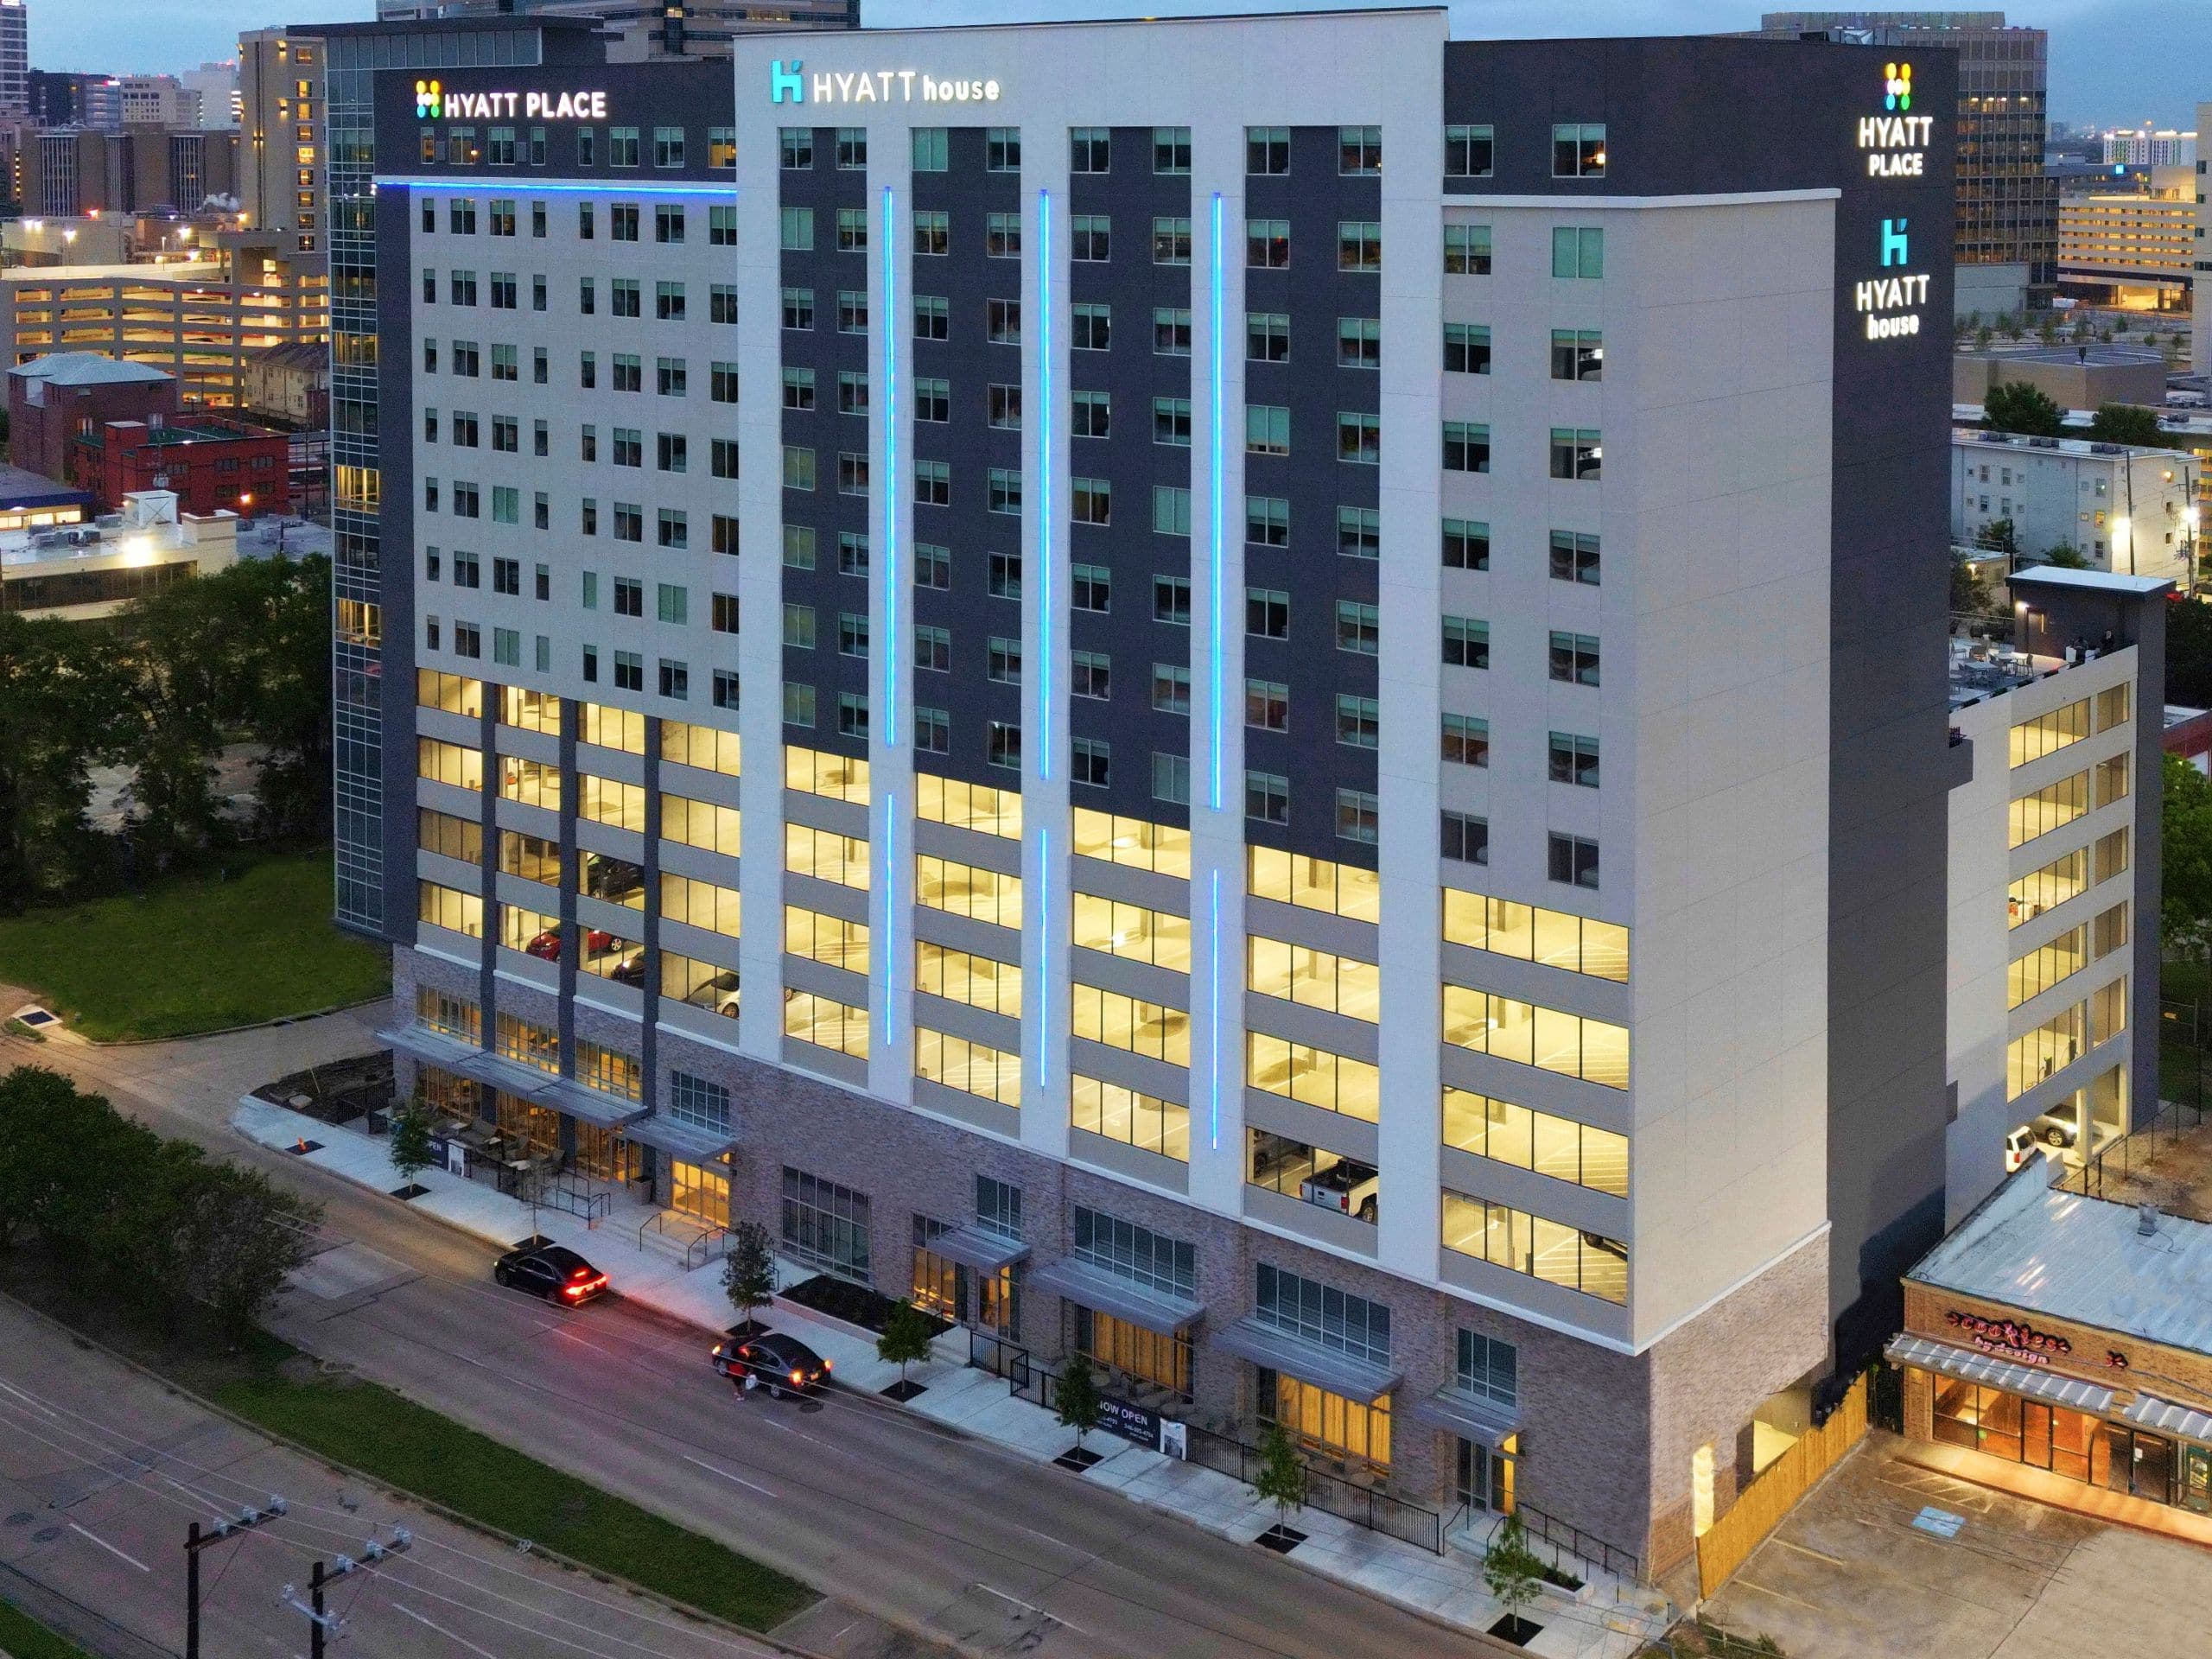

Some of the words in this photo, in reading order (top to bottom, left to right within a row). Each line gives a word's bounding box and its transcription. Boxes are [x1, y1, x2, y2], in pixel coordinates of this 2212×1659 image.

[813, 71, 916, 103] HYATT
[923, 74, 1000, 101] house
[444, 92, 518, 118] HYATT
[525, 92, 607, 118] PLACE
[1859, 116, 1934, 148] HYATT
[1868, 152, 1923, 177] PLACE
[1856, 274, 1930, 312] HYATT
[1866, 314, 1920, 340] house
[1122, 1408, 1147, 1425] OPEN
